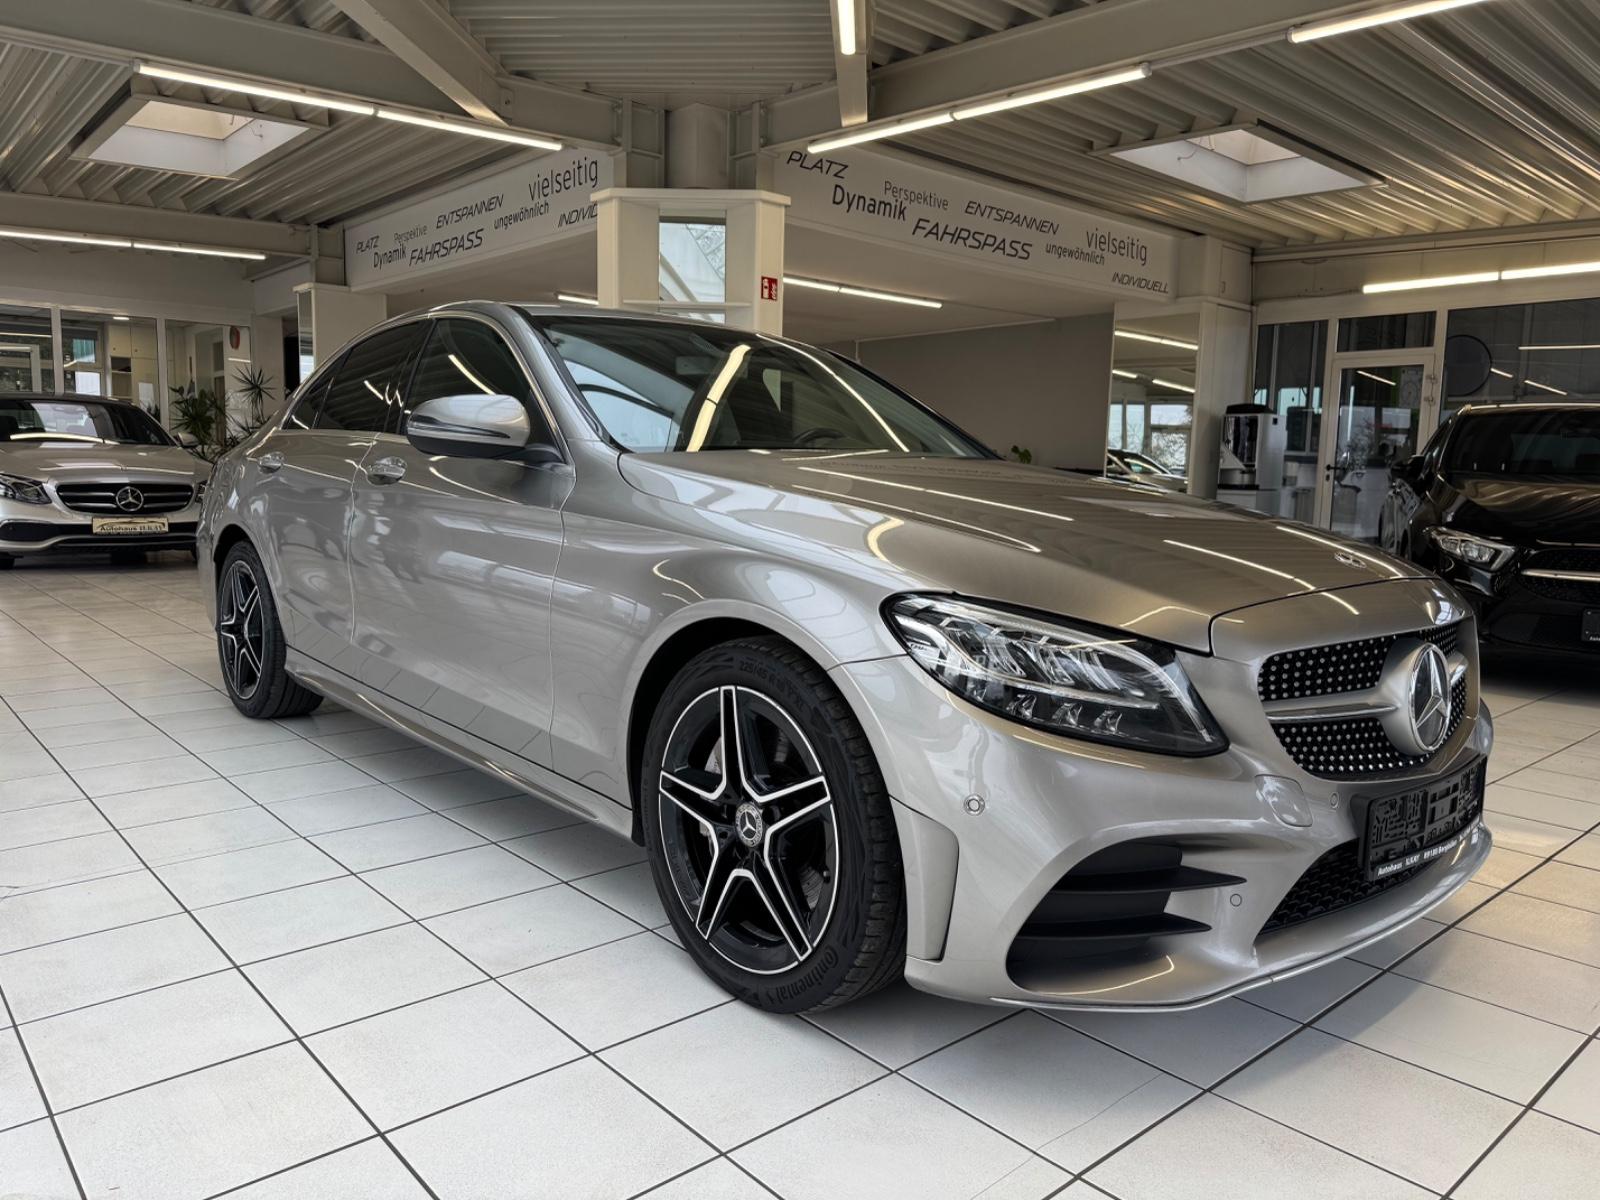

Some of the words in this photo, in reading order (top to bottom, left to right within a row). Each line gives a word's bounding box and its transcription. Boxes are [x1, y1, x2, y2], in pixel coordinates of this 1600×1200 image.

[528, 156, 598, 201] vielseitig
[786, 150, 849, 179] PLATZ
[832, 184, 907, 221] Dynamik
[884, 180, 949, 211] Perspektive
[436, 194, 504, 229] ENTSPANNEN
[493, 201, 549, 231] ungewöhnlich
[964, 200, 1060, 235] ENTSPANNEN
[356, 235, 380, 254] PLATZ
[393, 225, 428, 244] Perspektive
[408, 228, 484, 267] FAHRSPASS
[912, 217, 1033, 261] FAHRSPASS
[1086, 227, 1148, 266] vielseitig
[373, 243, 407, 270] Dynamik
[1045, 242, 1105, 266] ungewöhnlich
[1111, 271, 1169, 294] INDIVIDUELL
[1377, 861, 1403, 876] Autohaus
[776, 945, 839, 1004] Continental
